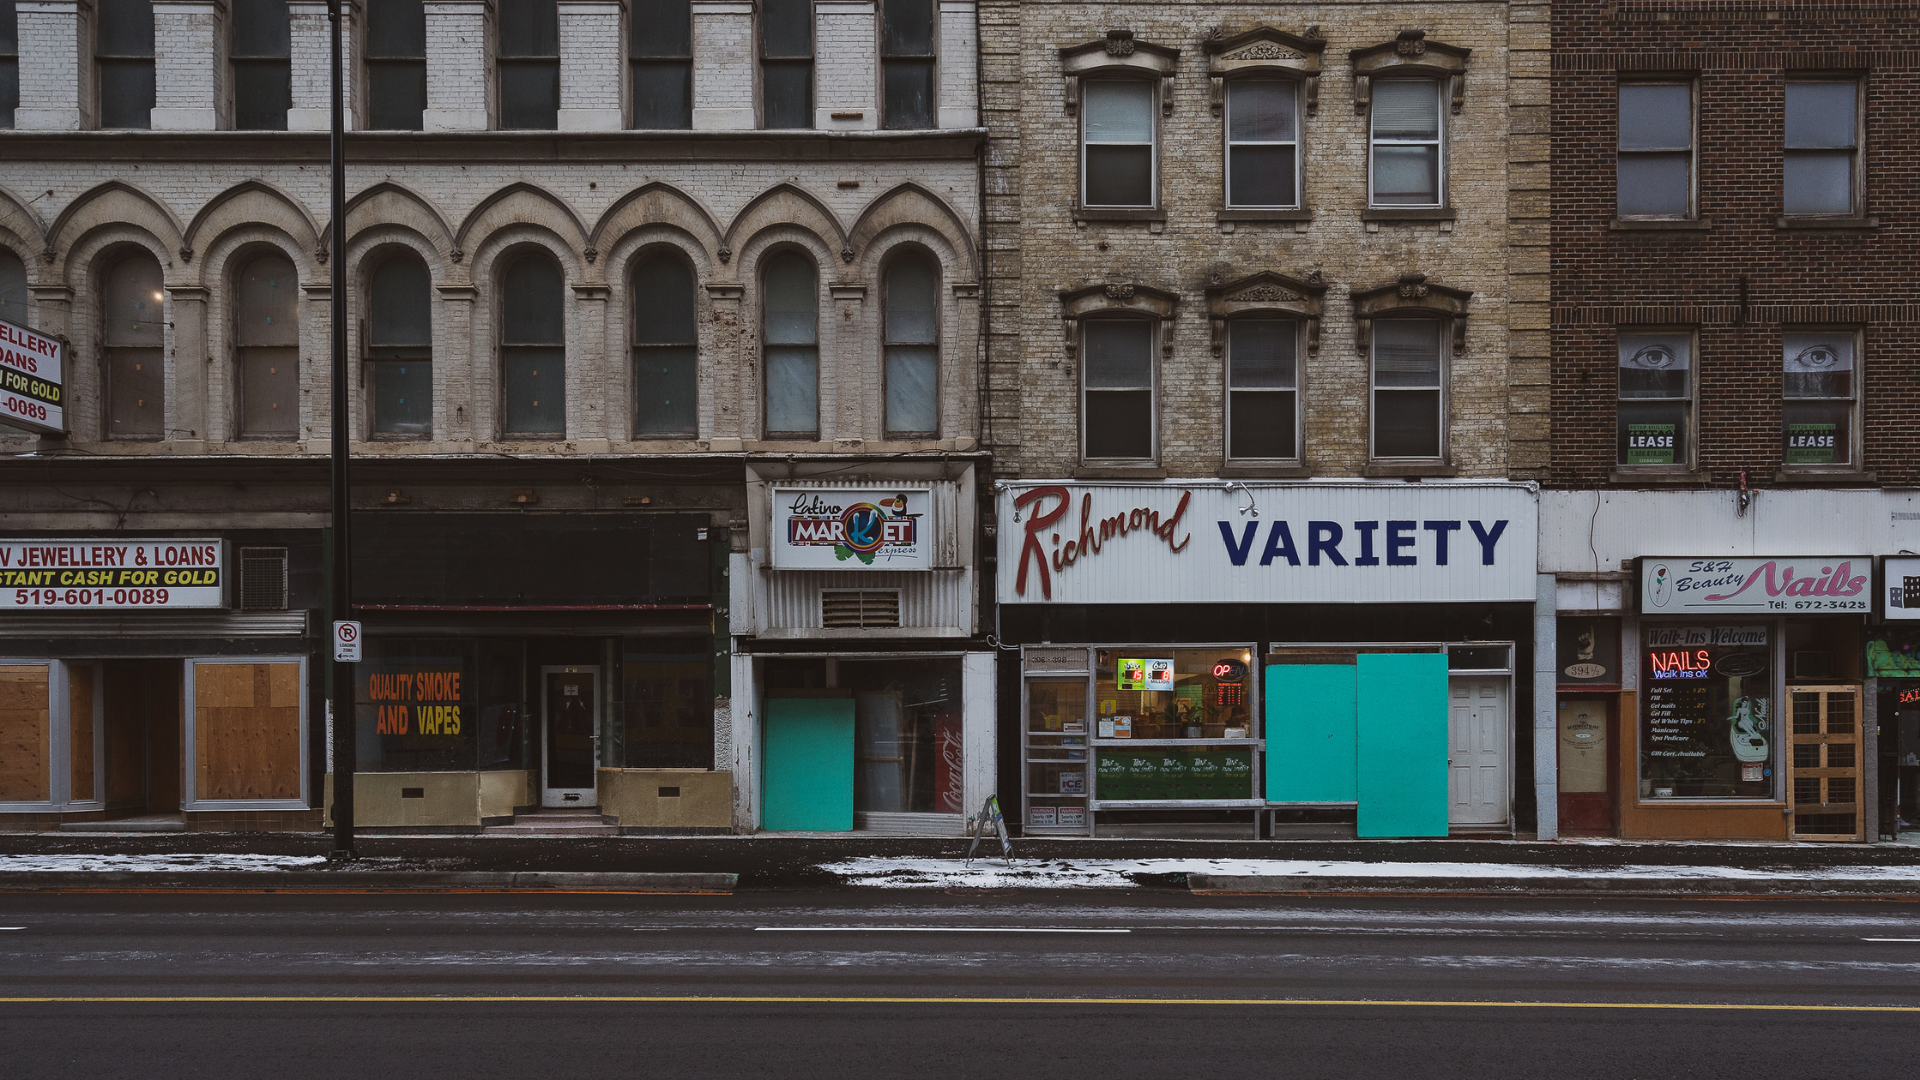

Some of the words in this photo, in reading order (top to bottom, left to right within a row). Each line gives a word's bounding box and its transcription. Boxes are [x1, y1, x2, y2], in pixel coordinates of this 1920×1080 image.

[6, 371, 28, 393] FOR
[31, 380, 60, 402] GOLD
[1630, 436, 1674, 447] LEASE
[1789, 435, 1835, 447] LEASE
[795, 509, 910, 543] MARKET
[1015, 486, 1191, 600] Richmond
[1217, 519, 1510, 567] VARIETY
[17, 546, 128, 567] JEWELLERY
[135, 546, 148, 566] &
[155, 545, 216, 566] LOANS
[877, 546, 917, 561] express
[1688, 561, 1734, 573] S&H
[0, 571, 55, 585] TANT
[60, 571, 114, 586] CASH
[119, 571, 158, 585] FOR
[164, 570, 217, 585] GOLD
[1675, 572, 1745, 592] Beauty
[1704, 561, 1867, 601] Nails
[15, 588, 169, 605] 519-601-0089
[1768, 601, 1787, 609] Tel:
[1794, 601, 1867, 609] 672-3428
[1650, 629, 1706, 645] Walk-Ins
[1710, 628, 1766, 644] Welcome
[1651, 650, 1711, 672] NAILS
[1213, 664, 1245, 676] OPEN
[1571, 665, 1590, 675] 394
[1654, 669, 1678, 679] Walk
[1679, 669, 1694, 678] Ins
[370, 673, 413, 700] QUALITY
[417, 672, 460, 701] SMOKE
[376, 705, 408, 735] AND
[417, 705, 460, 735] VAPES
[1062, 780, 1082, 788] ICE
